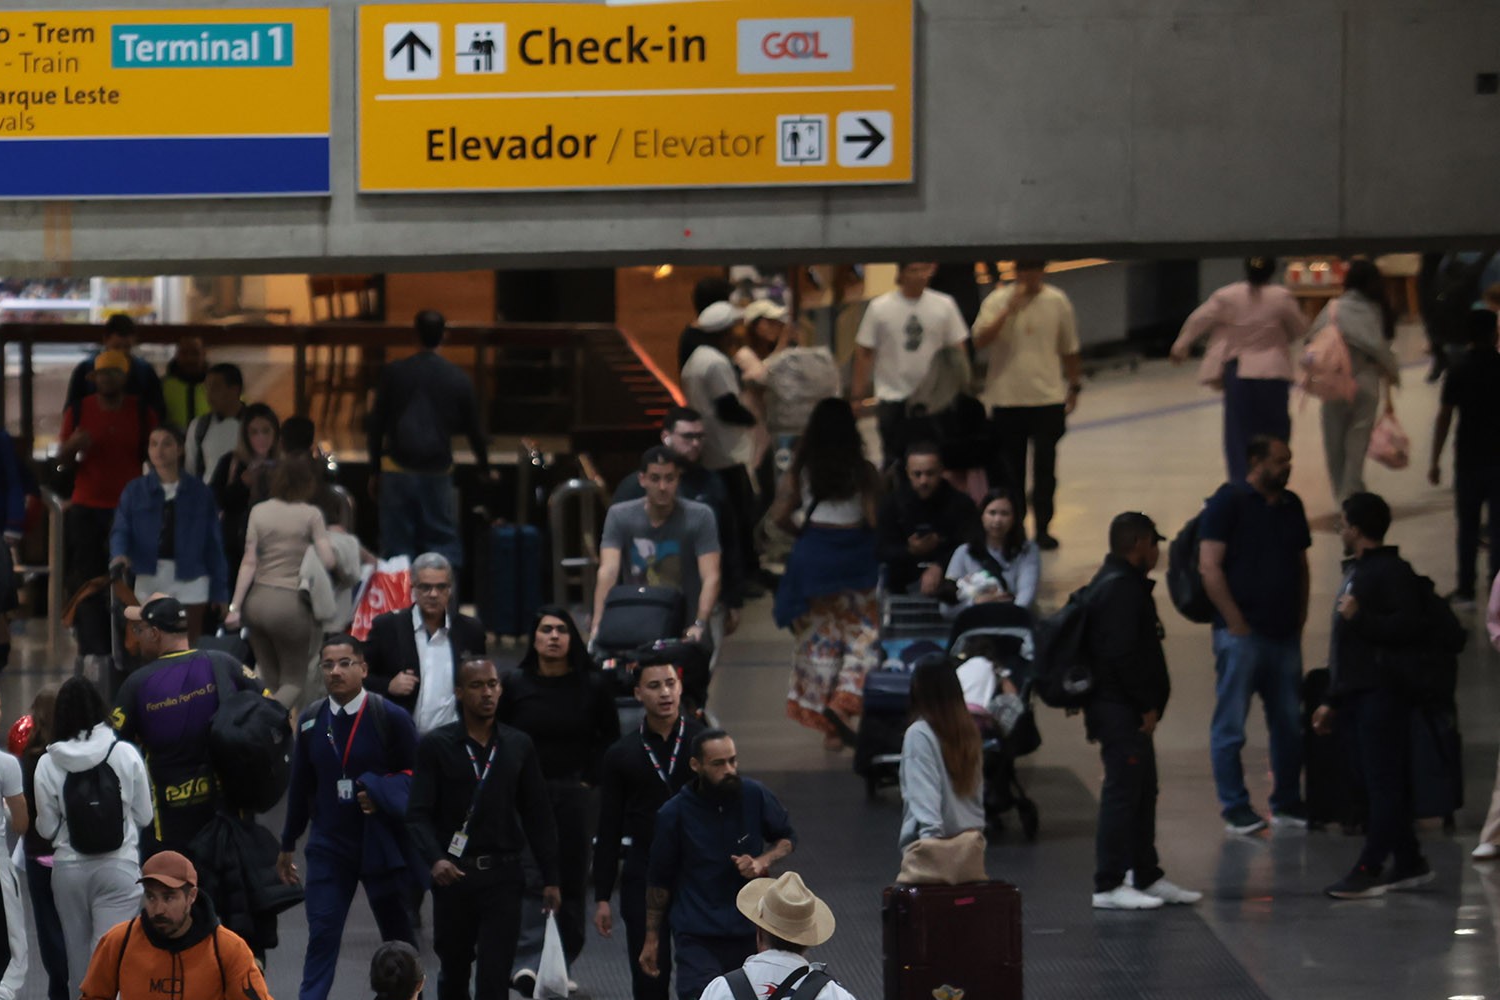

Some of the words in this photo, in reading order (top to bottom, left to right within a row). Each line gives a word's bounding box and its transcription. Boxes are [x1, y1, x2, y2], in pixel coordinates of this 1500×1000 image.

[33, 22, 95, 43] Trem
[119, 31, 259, 61] Terminal
[268, 27, 283, 60] 1
[519, 25, 706, 65] Check-in
[19, 51, 79, 73] Train
[65, 86, 120, 104] Leste
[427, 125, 597, 161] Elevador
[607, 128, 623, 164] /
[634, 129, 766, 158] Elevator
